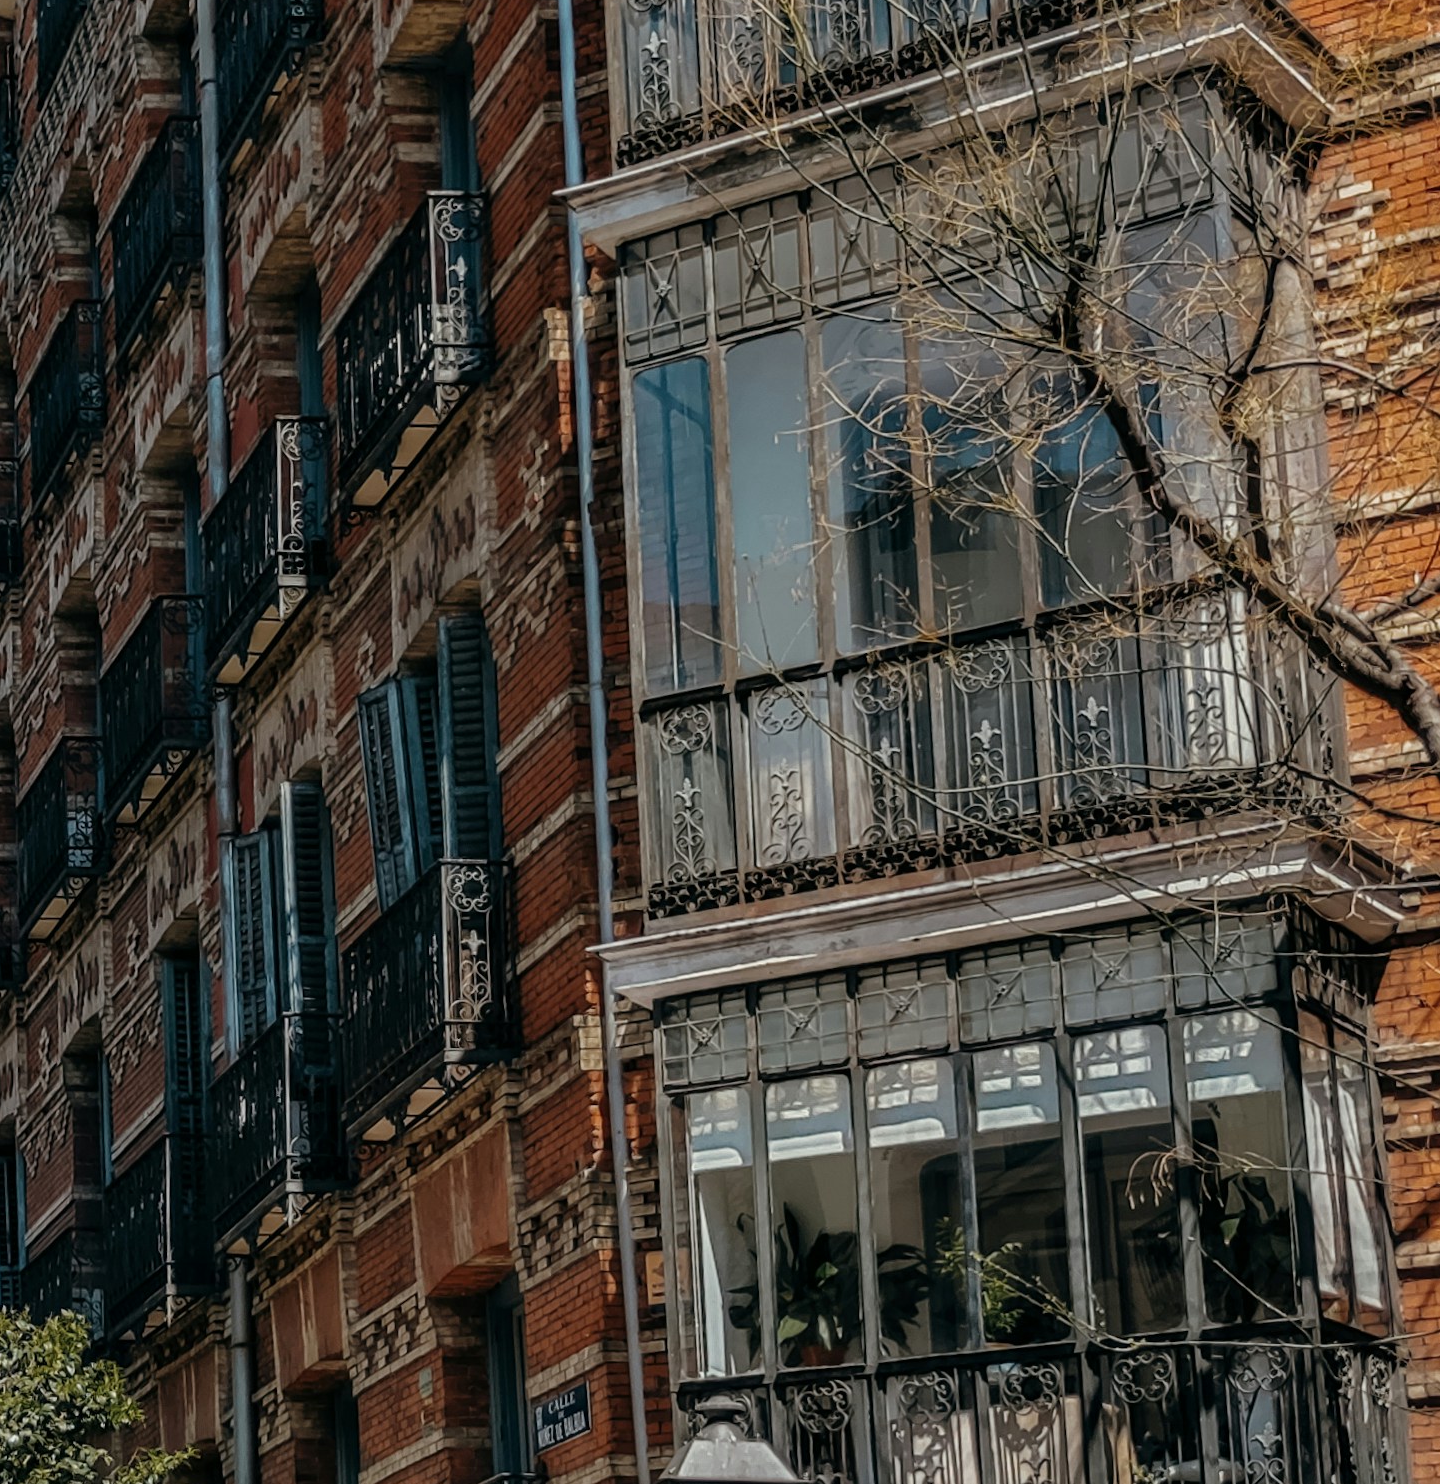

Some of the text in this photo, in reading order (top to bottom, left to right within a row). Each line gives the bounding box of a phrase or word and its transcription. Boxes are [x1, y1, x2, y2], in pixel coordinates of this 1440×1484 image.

[548, 1391, 576, 1414] CALLE
[555, 1422, 564, 1441] DE
[563, 1410, 587, 1437] BALBOA
